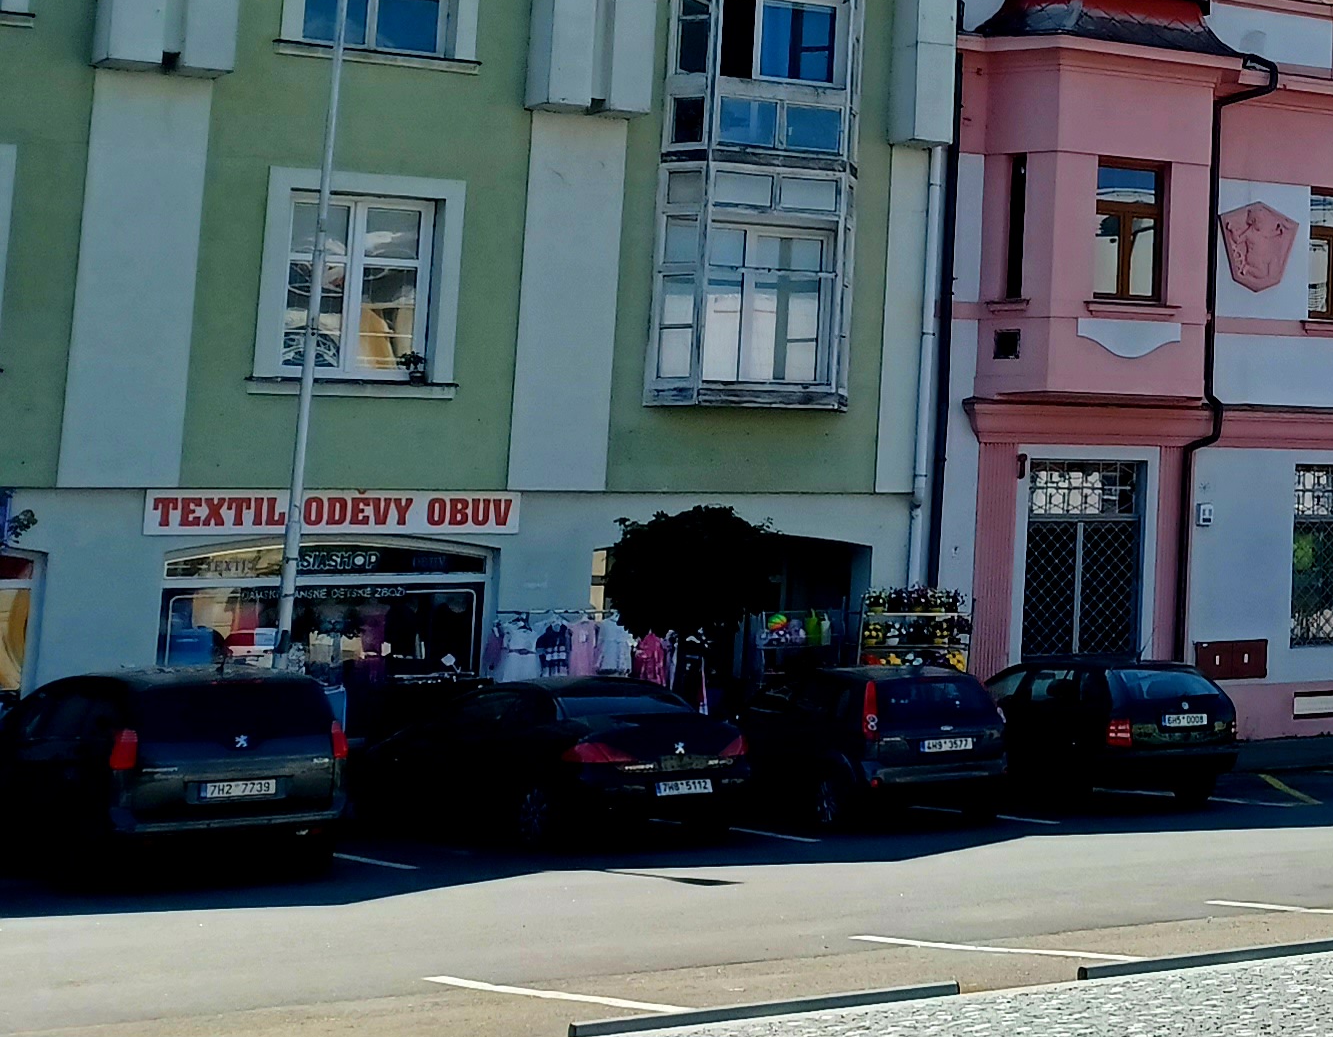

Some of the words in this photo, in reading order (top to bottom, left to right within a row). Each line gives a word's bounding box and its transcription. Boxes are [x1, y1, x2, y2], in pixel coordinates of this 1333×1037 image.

[153, 496, 286, 528] TEXTIL
[302, 489, 414, 527] ODĚVY
[426, 497, 513, 527] OBUV
[296, 551, 381, 571] SIASHOP
[209, 783, 233, 796] 7H2
[241, 781, 271, 794] 7739
[687, 779, 708, 790] 5112
